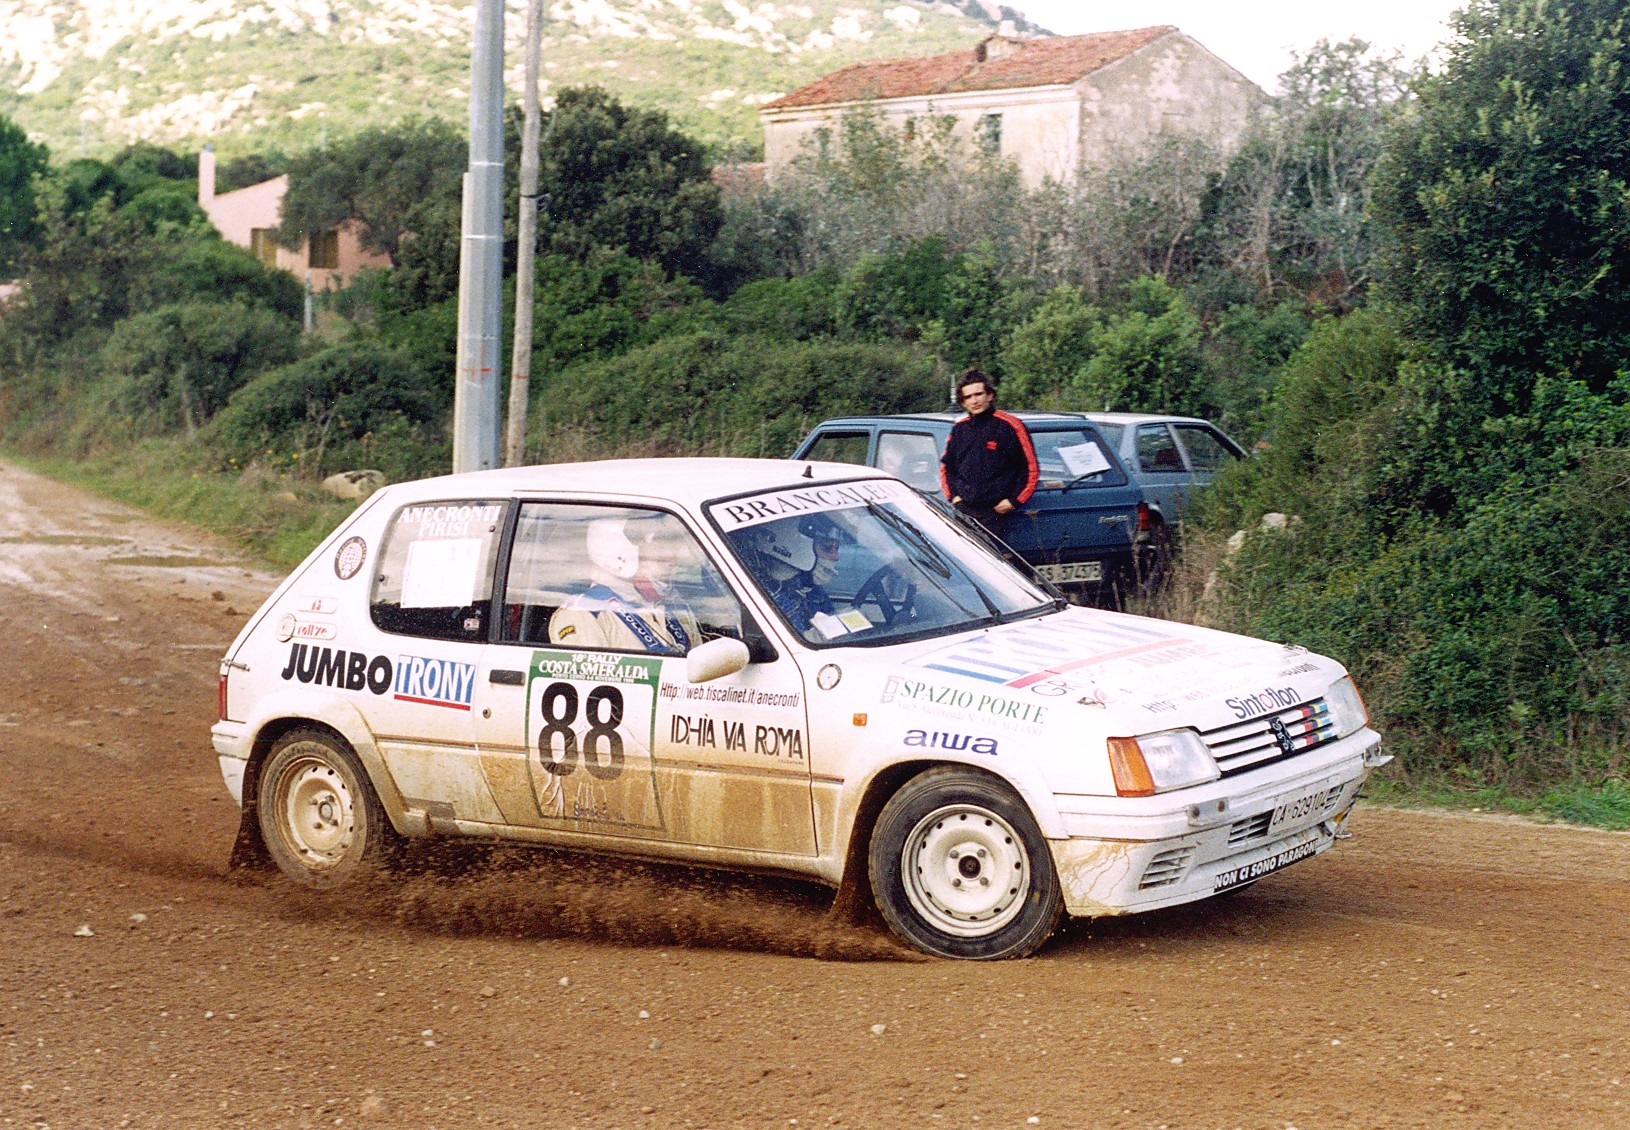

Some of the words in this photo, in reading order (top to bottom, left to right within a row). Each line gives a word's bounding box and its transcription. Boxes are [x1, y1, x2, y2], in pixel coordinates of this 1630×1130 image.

[397, 505, 502, 523] ANECRONTI
[418, 521, 469, 537] PIRISI
[297, 624, 328, 637] rallye
[281, 643, 393, 696] JUMBO
[538, 659, 578, 674] COSTA
[579, 661, 649, 680] SMERALDA
[587, 654, 623, 665] RALLY
[398, 655, 476, 703] TRONY
[660, 681, 801, 708] Http://web.tiscalinet.it/anecronti
[900, 680, 973, 709] SPAZIO
[977, 694, 1049, 724] PORTE
[1224, 686, 1302, 719] Sintoflon
[538, 681, 625, 781] 88
[754, 725, 804, 760] ROMA
[1214, 870, 1238, 889] NON
[1240, 866, 1249, 880] CI
[1250, 857, 1277, 877] SONO
